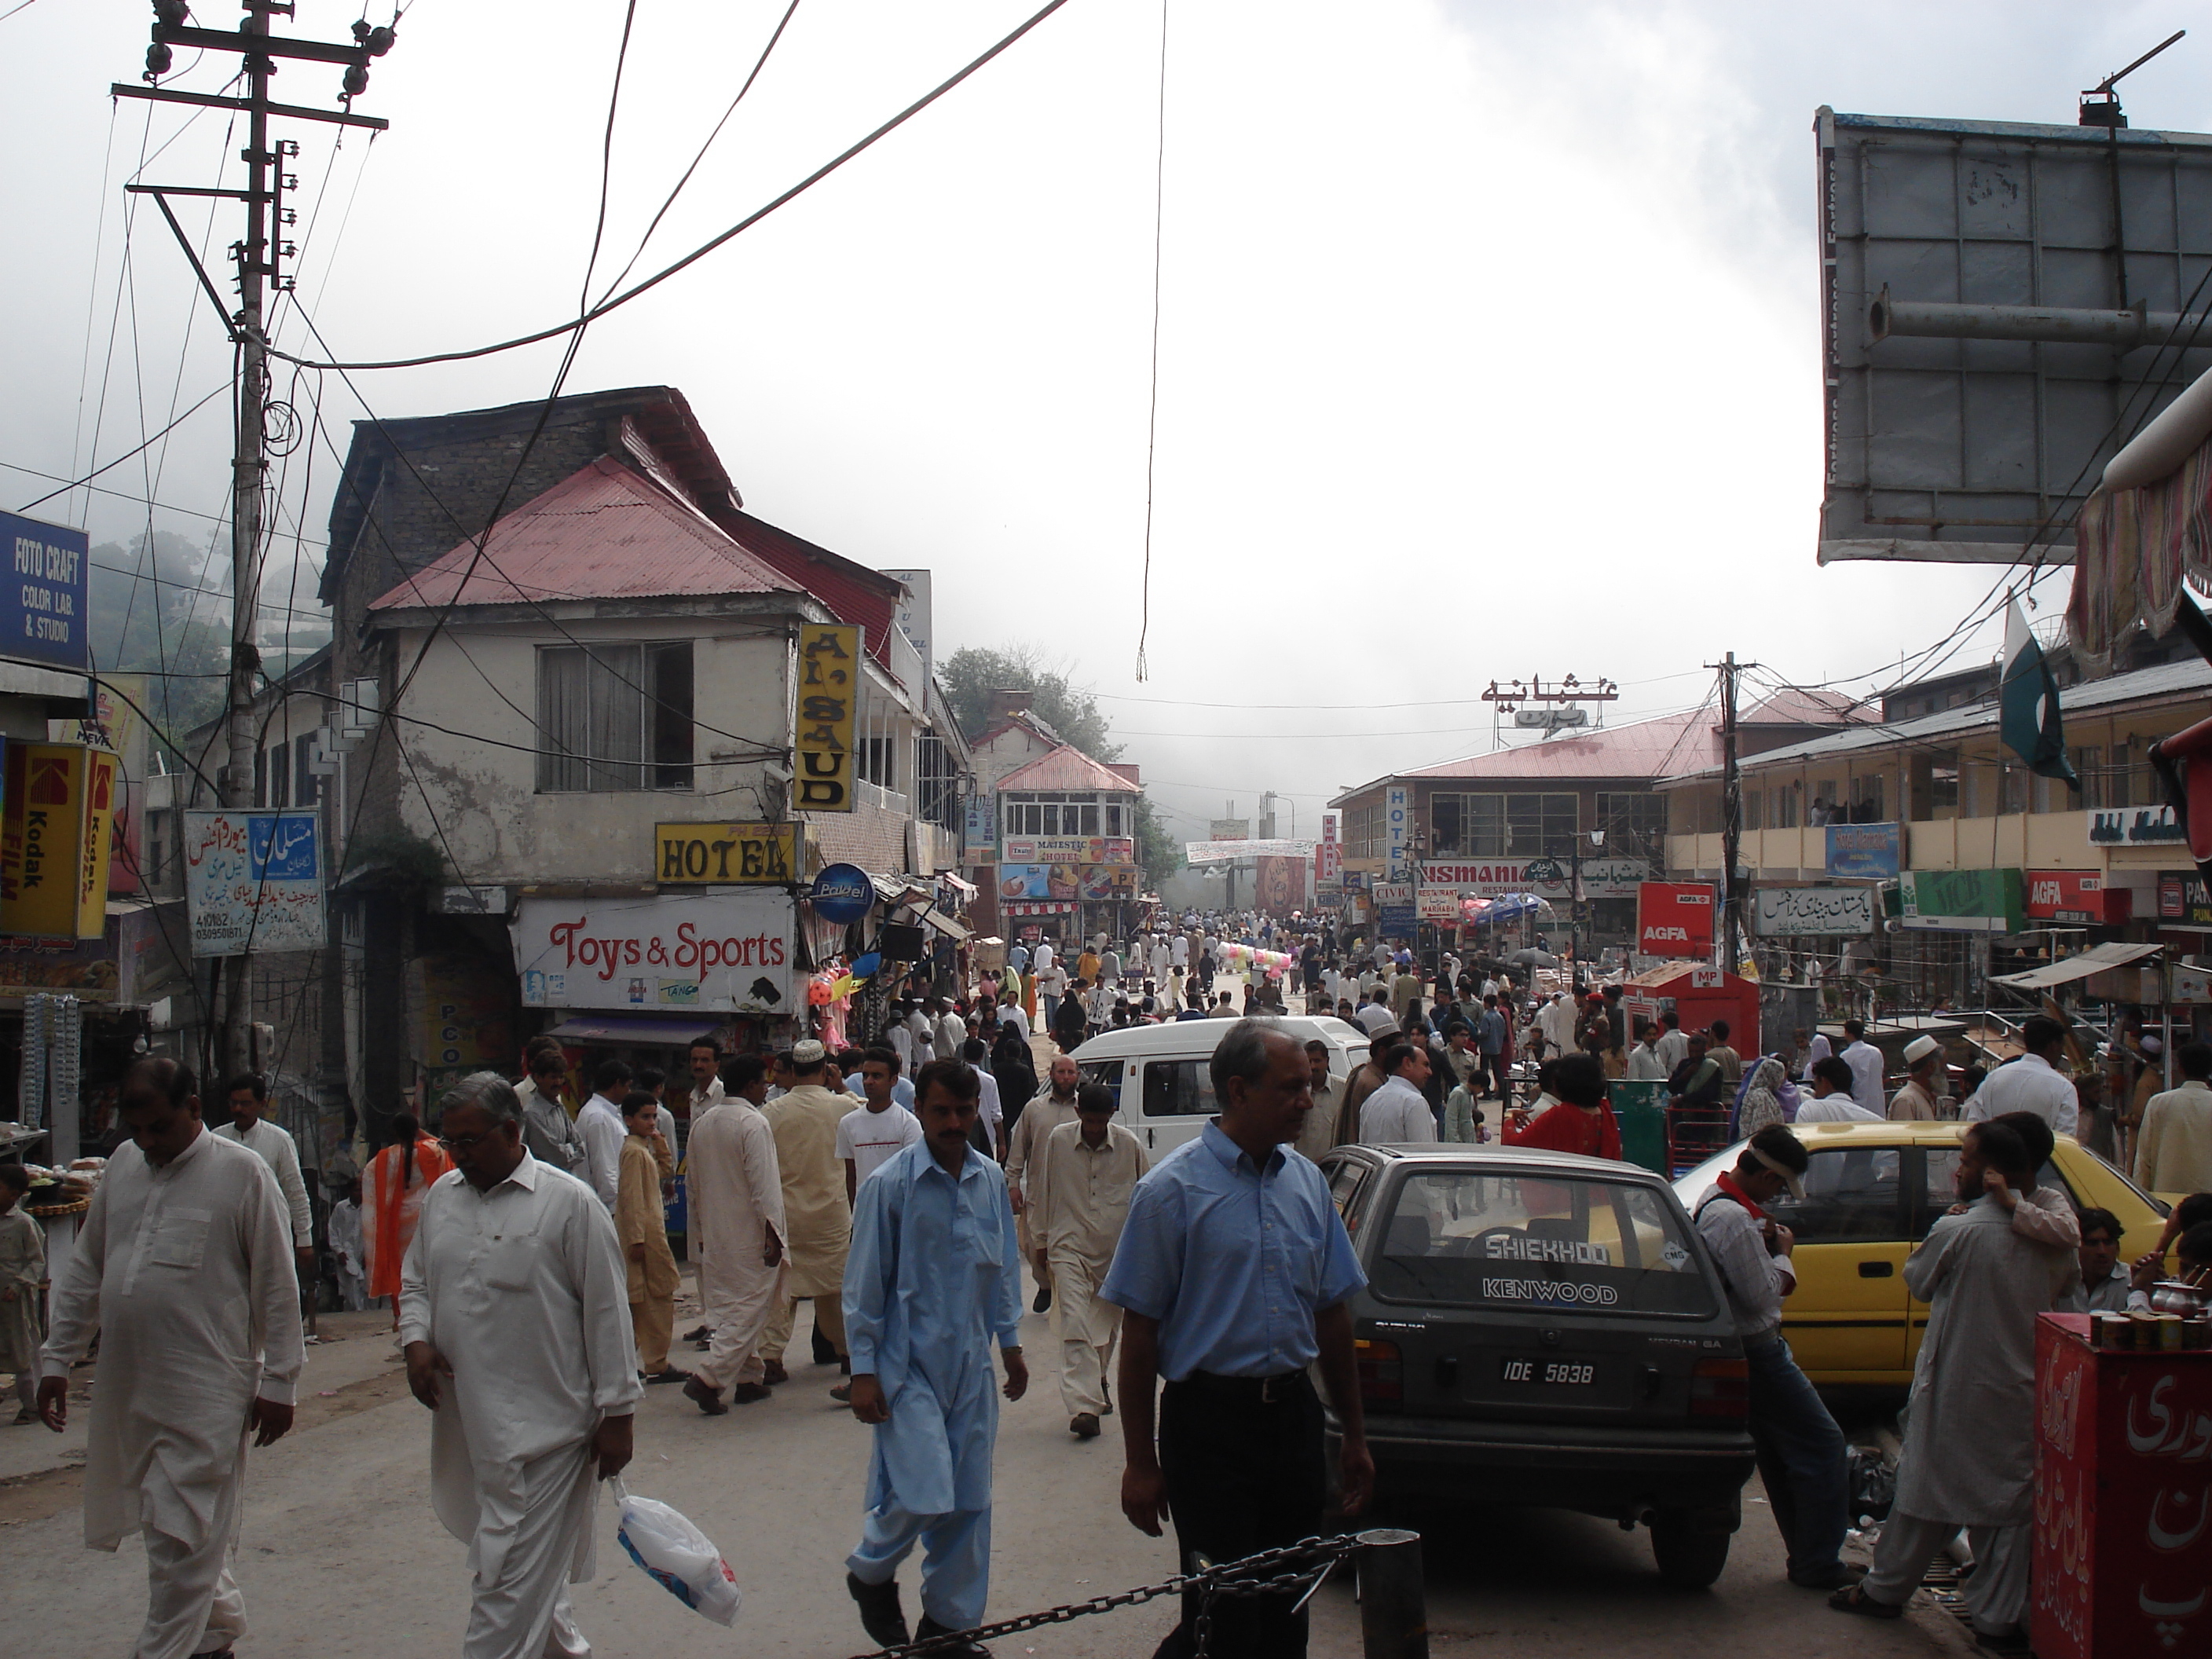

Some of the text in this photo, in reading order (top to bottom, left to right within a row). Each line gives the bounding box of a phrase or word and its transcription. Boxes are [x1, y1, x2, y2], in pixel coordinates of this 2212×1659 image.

[15, 537, 79, 585] FOTO CRAFT
[22, 584, 51, 612] COLOR
[25, 613, 69, 643] & STUDIO
[24, 811, 47, 889] Kodak
[88, 816, 101, 893] Kodak
[662, 840, 787, 877] HOTEL
[1038, 840, 1087, 849] MAJESTIC
[1, 833, 22, 901] FILM
[1376, 887, 1410, 899] CIVIC
[1829, 890, 1871, 921] پاکستان
[2031, 881, 2062, 905] AGFA
[1643, 926, 1688, 941] AGFA
[550, 916, 785, 983] Toys & Sports
[661, 984, 698, 996] TANGO
[1698, 971, 1717, 982] MP
[441, 1005, 461, 1064] PCO
[1664, 1251, 1685, 1260] CNG
[1483, 1278, 1618, 1305] KENWOOD
[1503, 1361, 1595, 1385] IDE 5838
